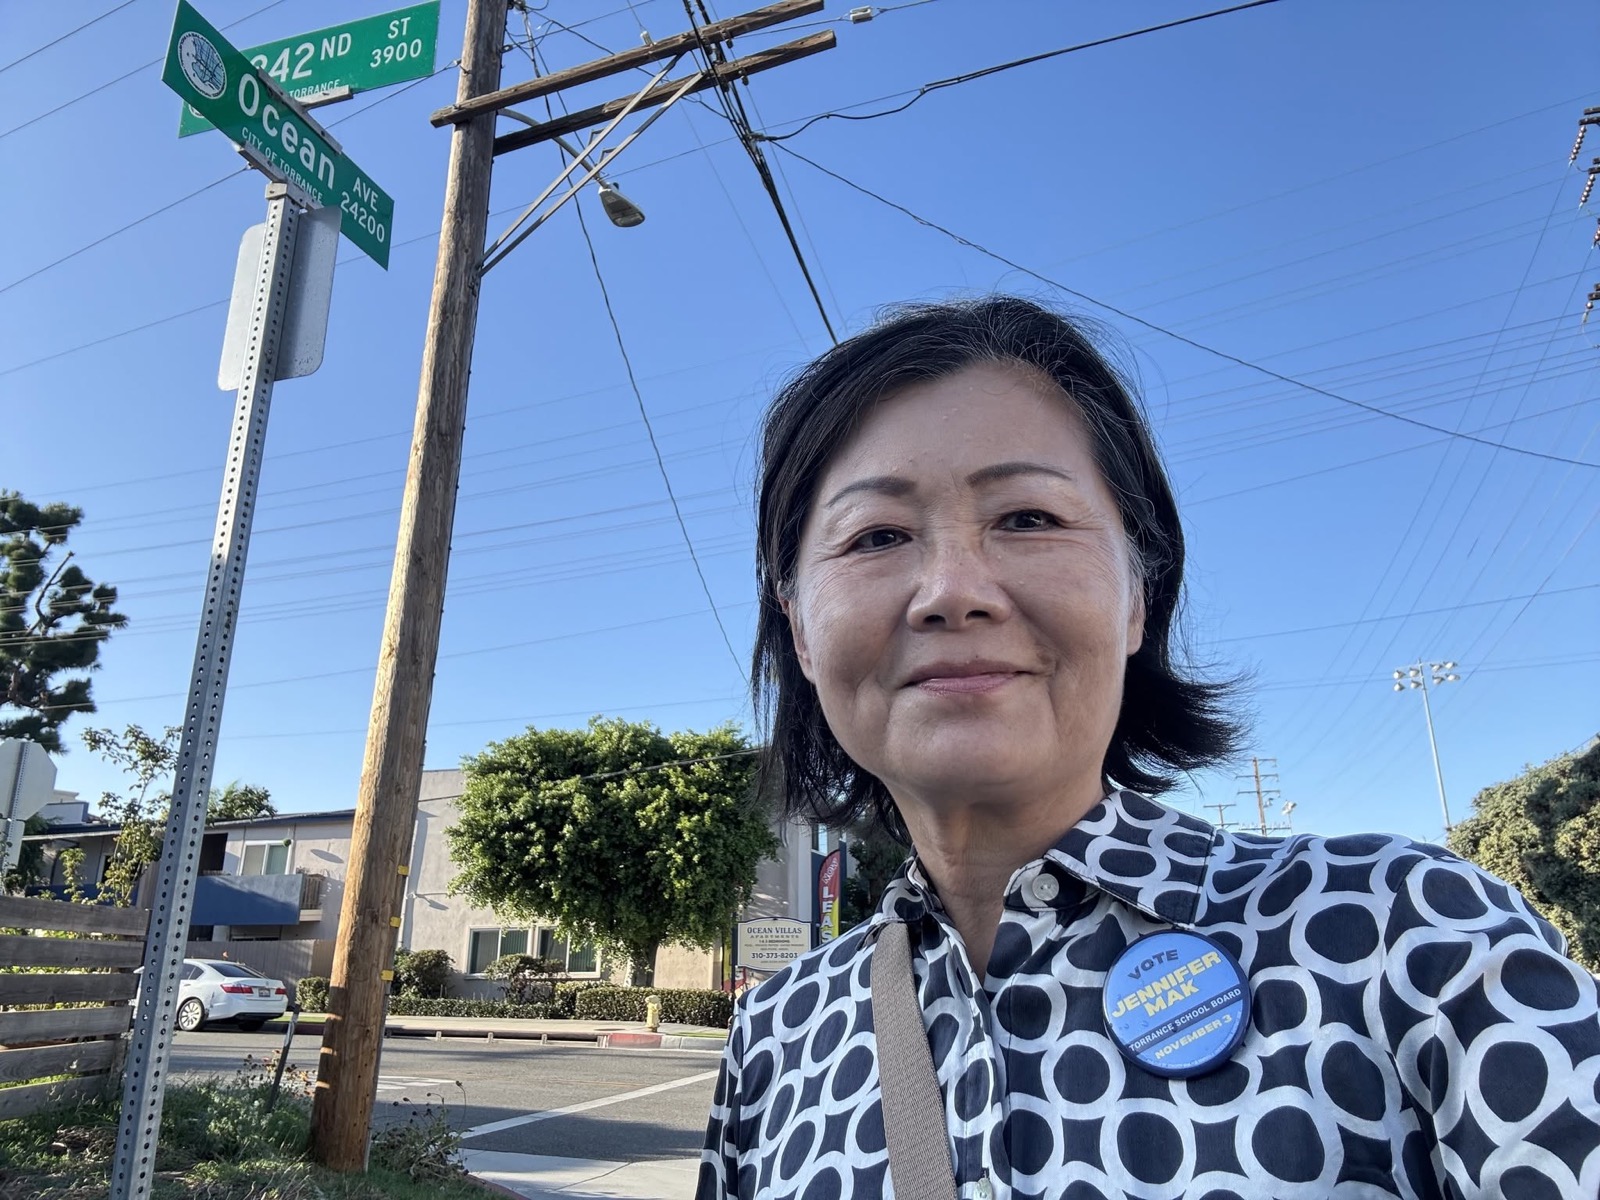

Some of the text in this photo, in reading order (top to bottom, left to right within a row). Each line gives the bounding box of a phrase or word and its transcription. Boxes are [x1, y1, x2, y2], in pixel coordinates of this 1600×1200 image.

[320, 32, 352, 60] ND
[388, 17, 411, 39] ST
[370, 39, 422, 68] 3900
[289, 79, 341, 98] TORRANCE
[238, 73, 335, 190] Ocean
[242, 126, 323, 202] CITY OF TORRANCE
[353, 177, 378, 213] AVE
[341, 191, 385, 242] 24200
[747, 926, 802, 934] OCEAN VILLAS
[1128, 949, 1179, 980] VOTE
[1112, 951, 1222, 1018] JENNIFER
[1144, 978, 1200, 1017] MAK
[1128, 1023, 1174, 1052] TORRANCE
[1174, 1005, 1211, 1029] SCHOOL
[1211, 988, 1242, 1008] BOARD
[1154, 1019, 1223, 1060] NOVEMBER
[1223, 1013, 1233, 1024] 3
